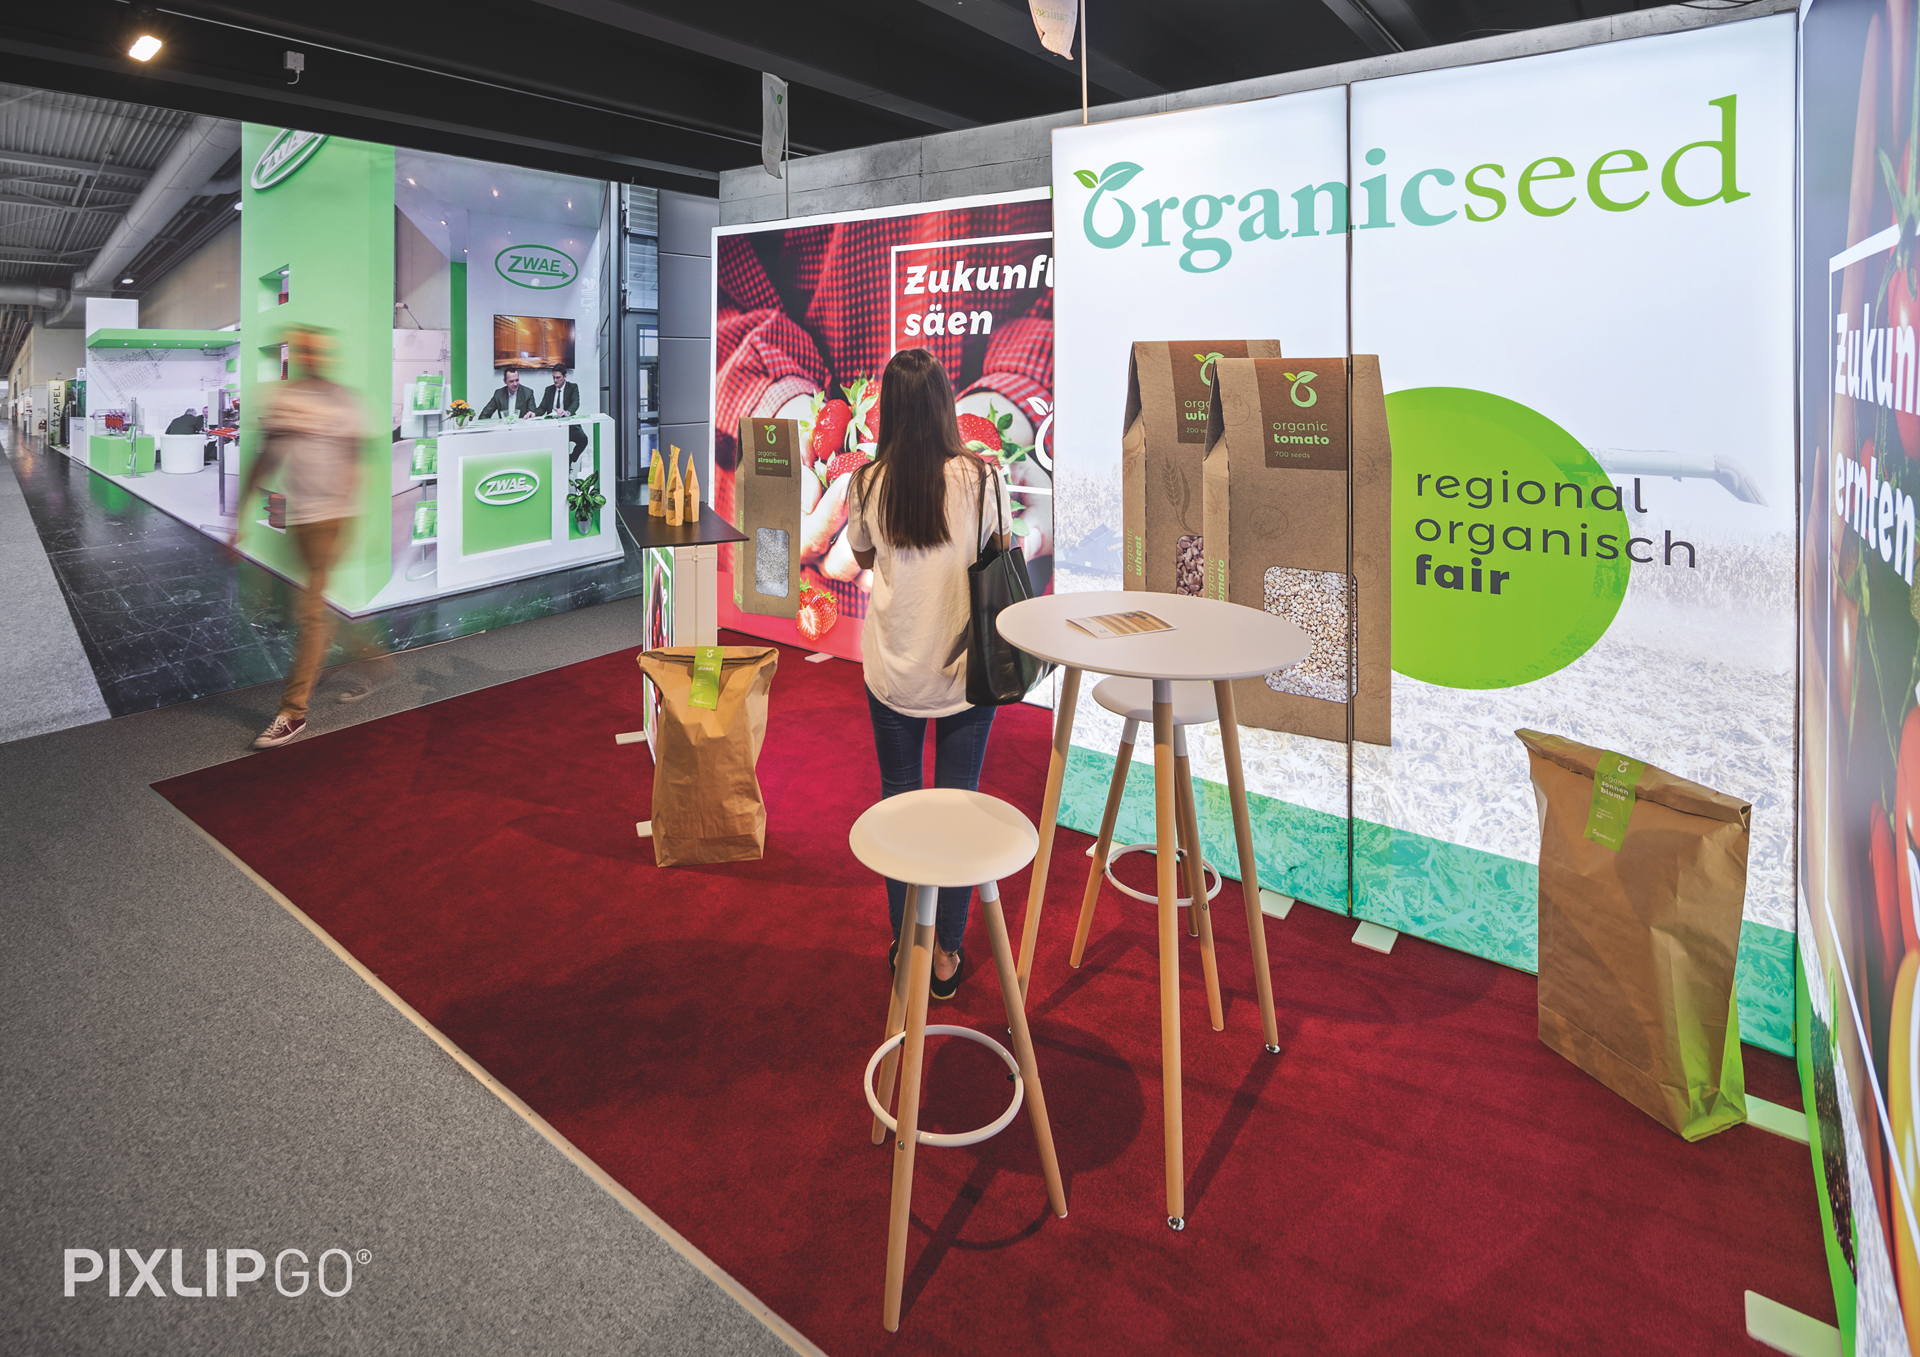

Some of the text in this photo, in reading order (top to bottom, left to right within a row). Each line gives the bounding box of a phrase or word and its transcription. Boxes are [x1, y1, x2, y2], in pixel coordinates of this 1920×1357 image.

[1073, 93, 1750, 273] Organicseed
[508, 255, 563, 274] ZWAE
[904, 304, 993, 336] säen
[50, 385, 61, 427] AZAPEL
[1185, 410, 1208, 421] wh
[1273, 420, 1328, 433] organic
[1273, 433, 1330, 445] tomato
[757, 457, 789, 466] strawberry
[484, 477, 527, 497] ZWAE
[1417, 470, 1648, 514] regional
[1835, 452, 1916, 586] ernten
[1126, 527, 1134, 572] organic
[1415, 518, 1695, 568] organisch
[1416, 554, 1510, 595] fair
[1600, 787, 1626, 802] blume
[1601, 781, 1629, 796] sonnen
